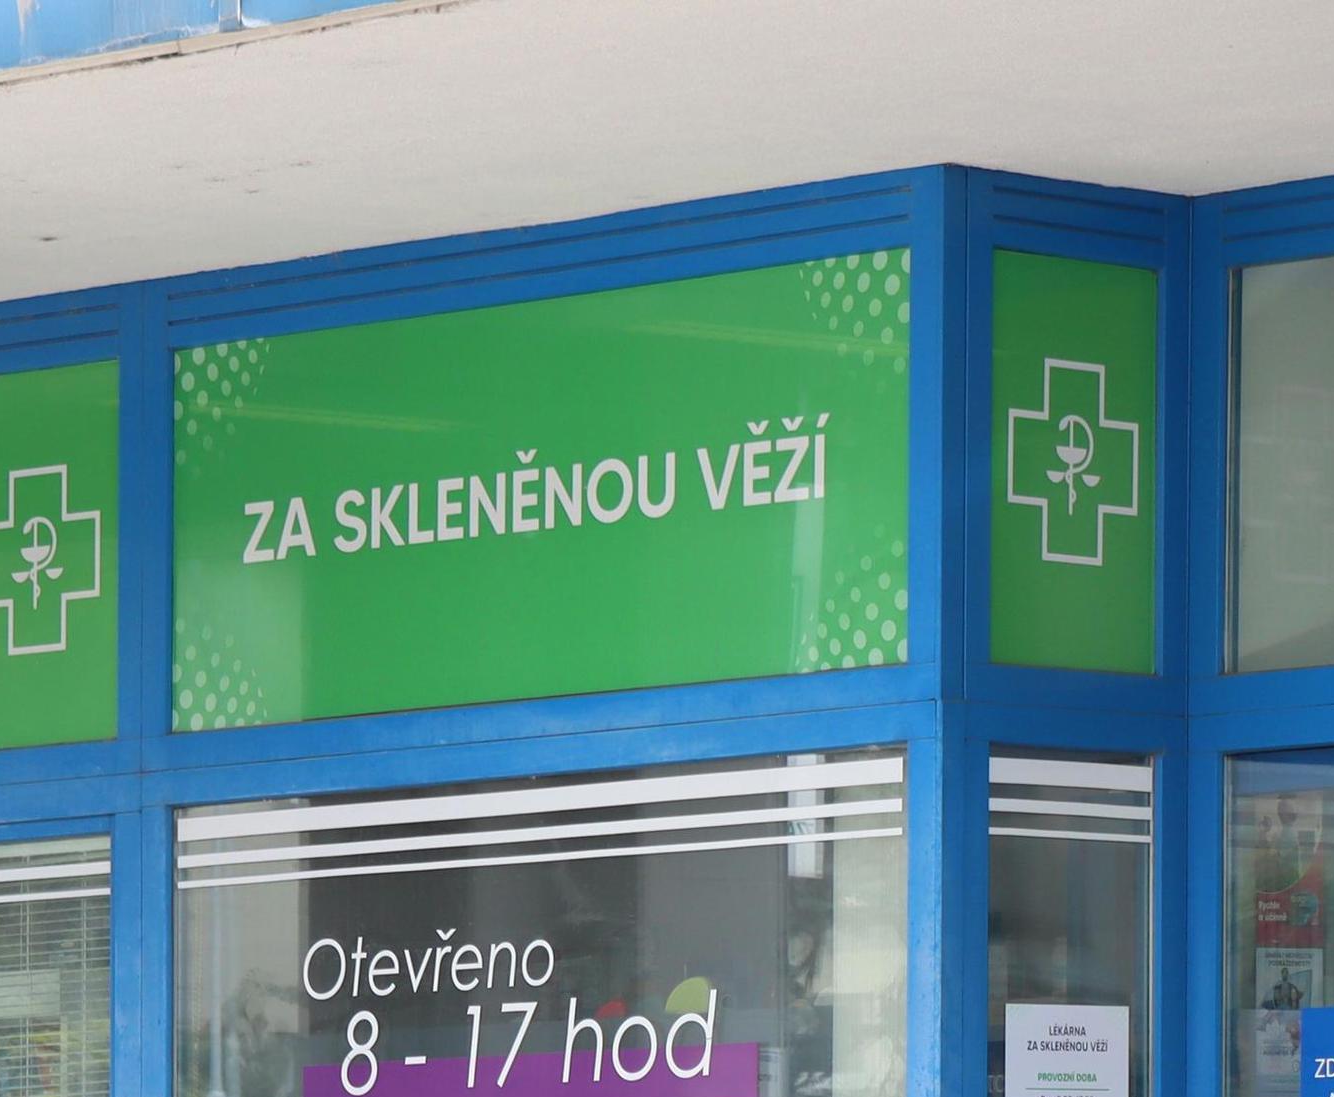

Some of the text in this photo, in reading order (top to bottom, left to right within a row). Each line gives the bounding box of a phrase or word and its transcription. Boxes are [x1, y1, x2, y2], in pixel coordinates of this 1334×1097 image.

[242, 412, 830, 564] ZA SKLENĚNOU VĚŽÍ
[303, 928, 555, 1001] Otevřeno
[341, 988, 717, 1096] 8 - 17 hod
[1027, 1038, 1108, 1052] ZA SKLENĚNOU VĚŽÍ
[1049, 1023, 1086, 1036] LÉKÁRNA
[1037, 1071, 1097, 1082] PROVOZNÍ DOBA
